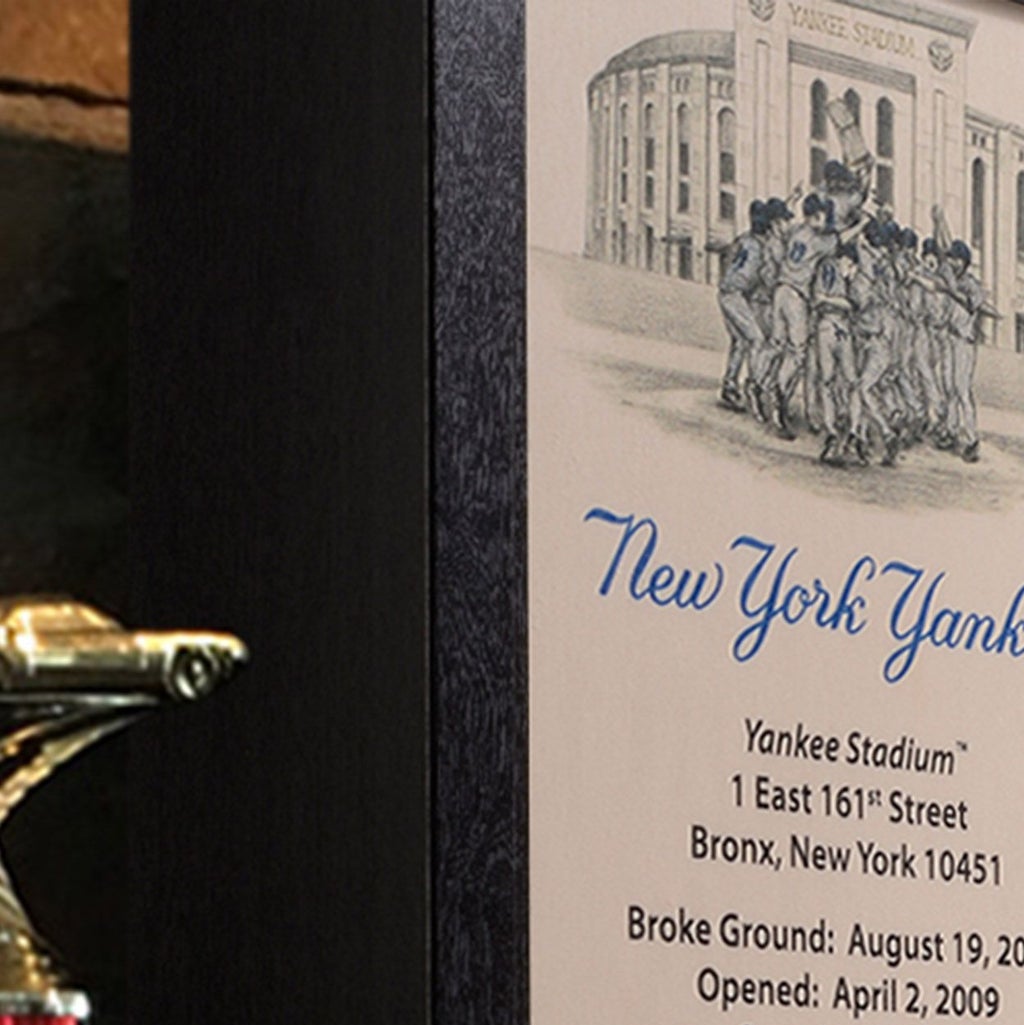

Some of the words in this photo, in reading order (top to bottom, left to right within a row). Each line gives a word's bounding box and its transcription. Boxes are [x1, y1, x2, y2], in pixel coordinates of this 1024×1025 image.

[585, 507, 724, 611] New
[731, 535, 875, 663] York
[744, 718, 840, 763] Yankee
[732, 774, 742, 807] 1
[755, 775, 812, 815] East
[821, 784, 882, 820] 161st
[889, 790, 968, 831] Street
[691, 824, 782, 871] Bronx,
[790, 834, 851, 872] New
[856, 840, 916, 879] York
[925, 848, 1000, 886] 10451
[628, 905, 712, 946] Broke
[719, 912, 834, 956] Ground:
[847, 923, 944, 968] August
[953, 931, 990, 970] 19,
[697, 967, 819, 1012] Opened:
[832, 976, 897, 1020] April
[905, 981, 928, 1019] 2,
[935, 983, 1000, 1018] 2009
